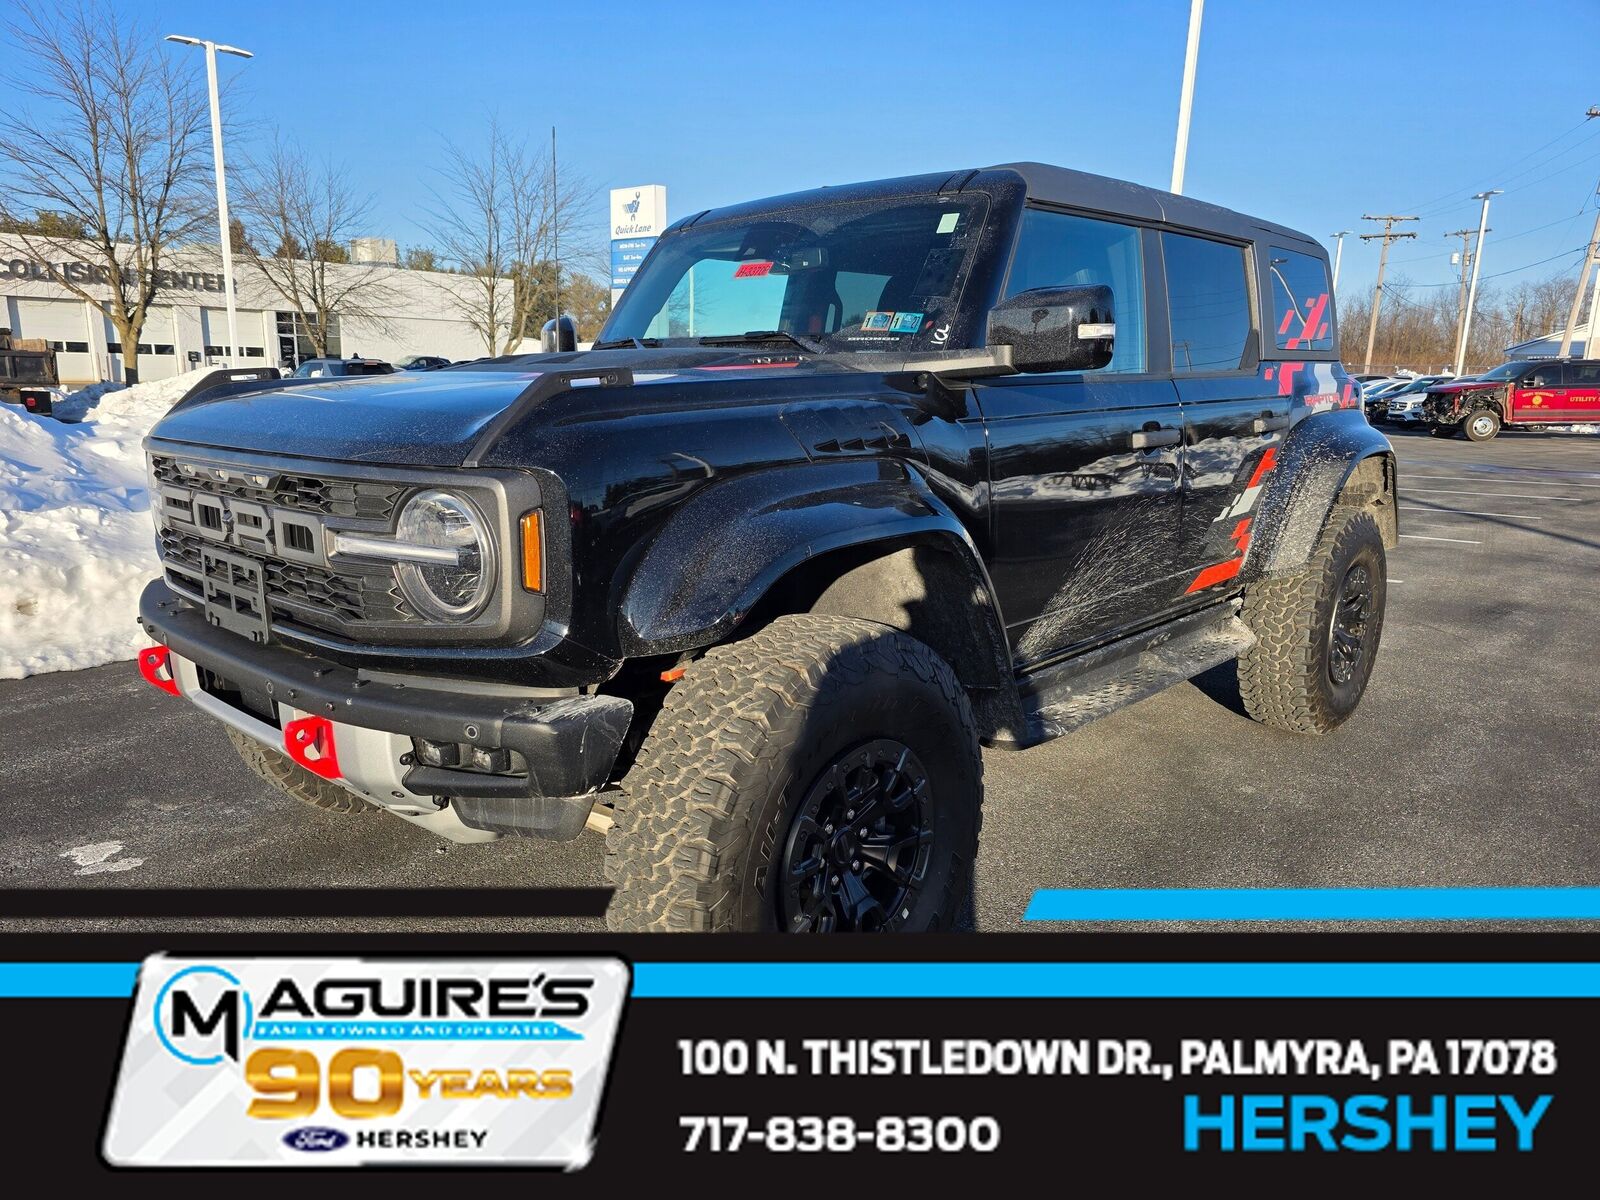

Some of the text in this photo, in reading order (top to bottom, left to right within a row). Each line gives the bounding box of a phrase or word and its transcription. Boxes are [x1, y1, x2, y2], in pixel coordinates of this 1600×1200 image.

[615, 224, 652, 236] Quick Lane
[1304, 393, 1342, 408] RAPTOR
[160, 484, 326, 568] FORD
